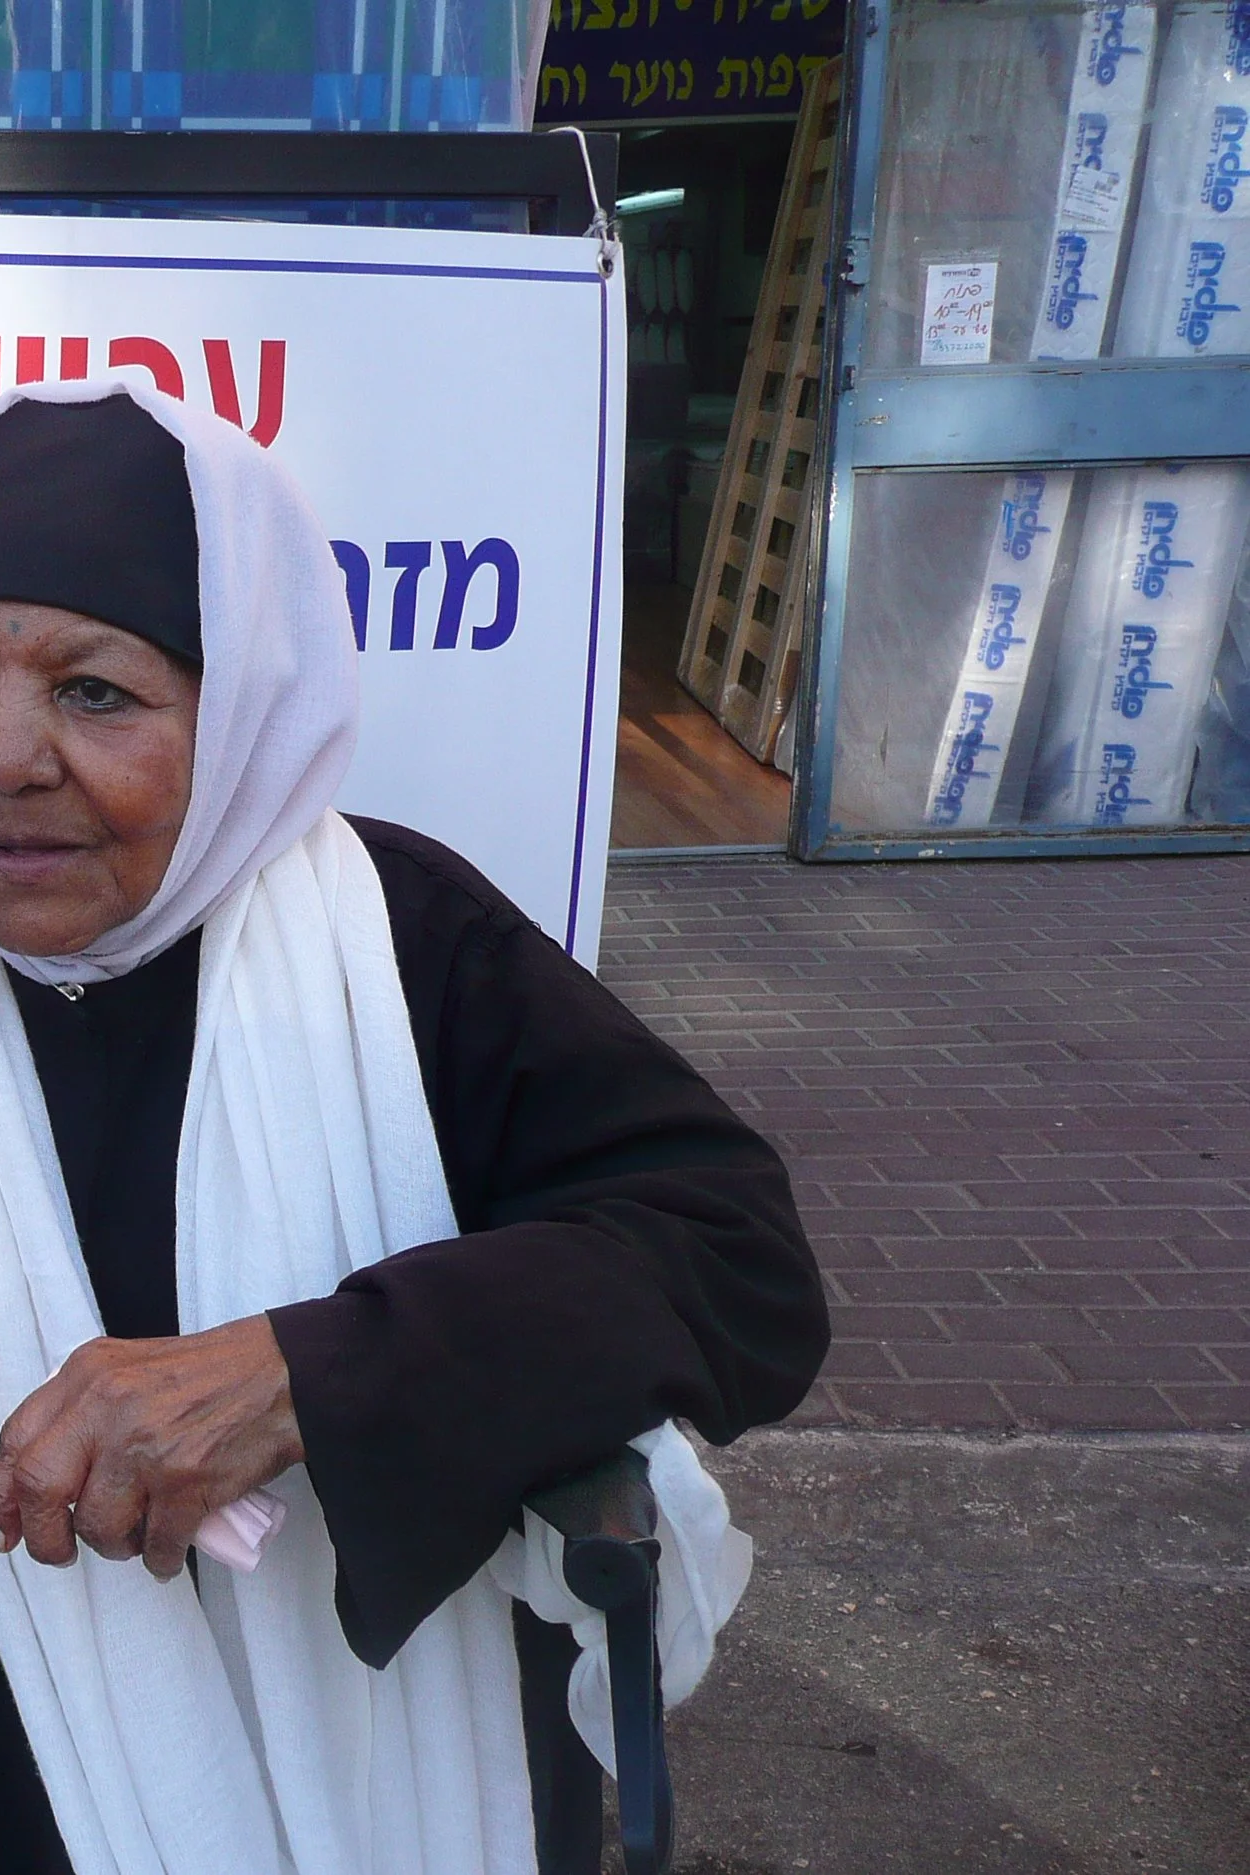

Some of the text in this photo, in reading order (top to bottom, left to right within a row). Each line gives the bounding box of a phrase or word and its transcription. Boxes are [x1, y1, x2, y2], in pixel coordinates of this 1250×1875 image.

[1096, 8, 1143, 87] פולי
[541, 63, 587, 107] וח
[608, 58, 694, 107] נוער
[328, 537, 520, 652] מזר
